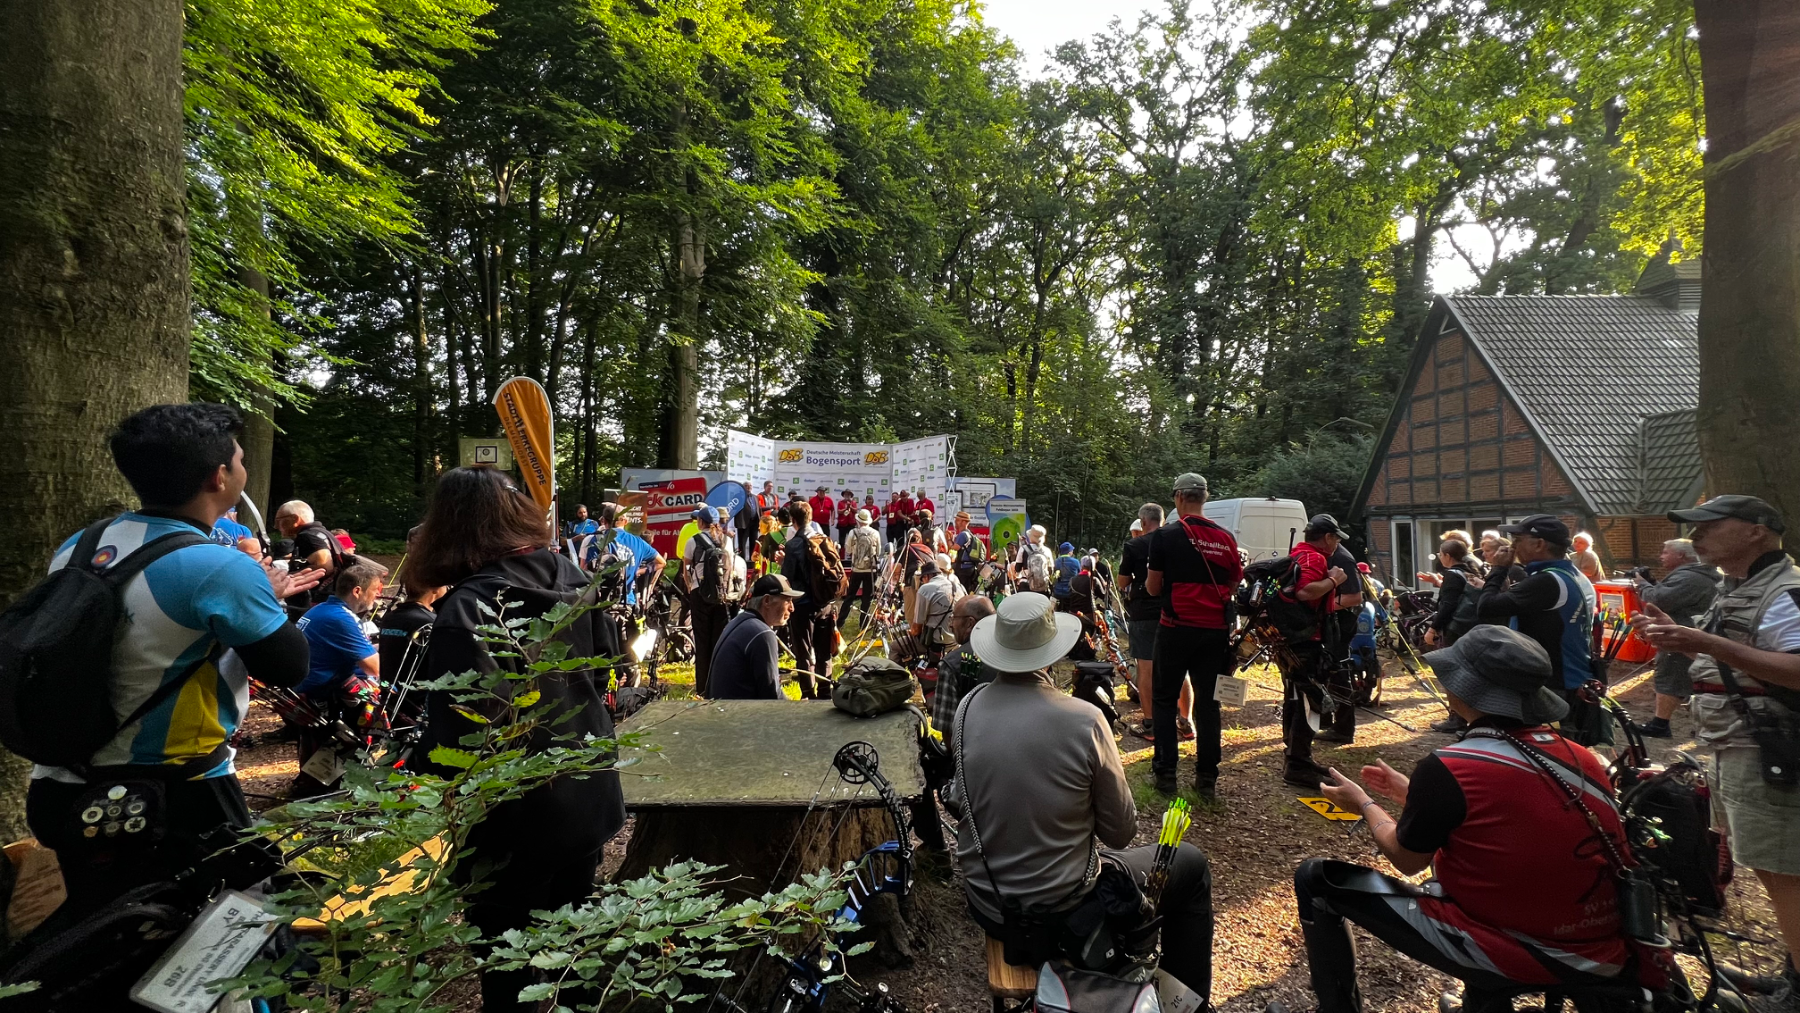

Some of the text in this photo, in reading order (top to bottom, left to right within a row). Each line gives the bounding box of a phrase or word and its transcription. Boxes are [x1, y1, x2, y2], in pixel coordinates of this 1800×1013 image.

[806, 456, 861, 467] Bogensport
[223, 907, 240, 924] BY
[203, 910, 265, 977] THTARASSERY
